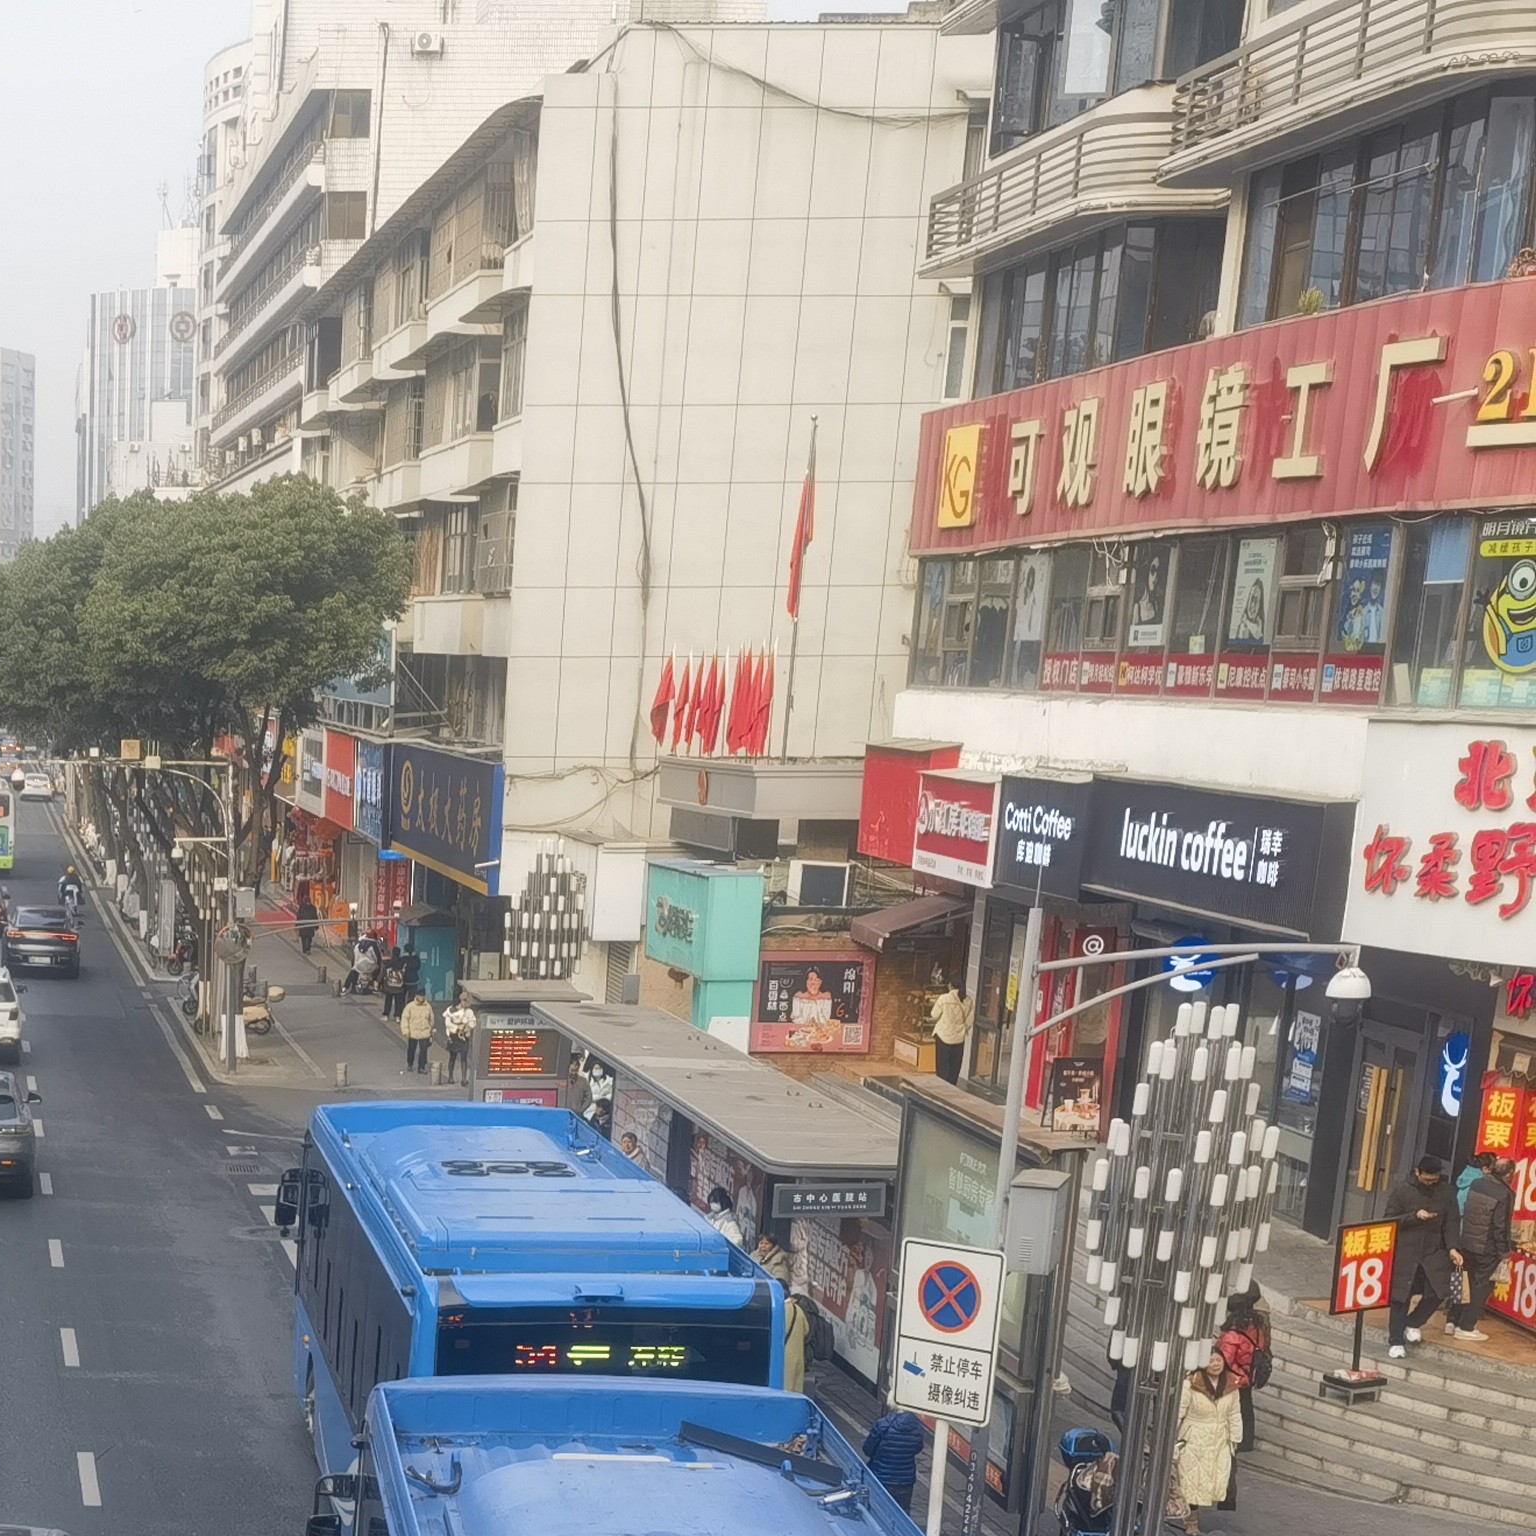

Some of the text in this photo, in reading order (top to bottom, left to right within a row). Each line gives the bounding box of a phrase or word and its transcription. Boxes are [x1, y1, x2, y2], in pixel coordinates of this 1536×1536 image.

[1007, 335, 1448, 516] 可观眼镜工厂
[1043, 660, 1078, 686] 授权门店
[1454, 740, 1536, 812] 北
[1005, 801, 1033, 834] Cotti
[1033, 805, 1072, 841] Coffee
[1016, 839, 1052, 867] 库迪咖啡
[1120, 806, 1247, 881] luckin coffee
[1259, 827, 1284, 859] 瑞幸
[1256, 858, 1280, 888] 咖啡
[1363, 822, 1536, 920] 怀柔野
[1483, 1089, 1515, 1149] 板栗
[1343, 1227, 1392, 1258] 板栗
[1341, 1257, 1385, 1310] 18
[930, 1353, 983, 1381] 禁止停车
[927, 1383, 981, 1412] 摄像纠违
[963, 1451, 978, 1534] 03404224
